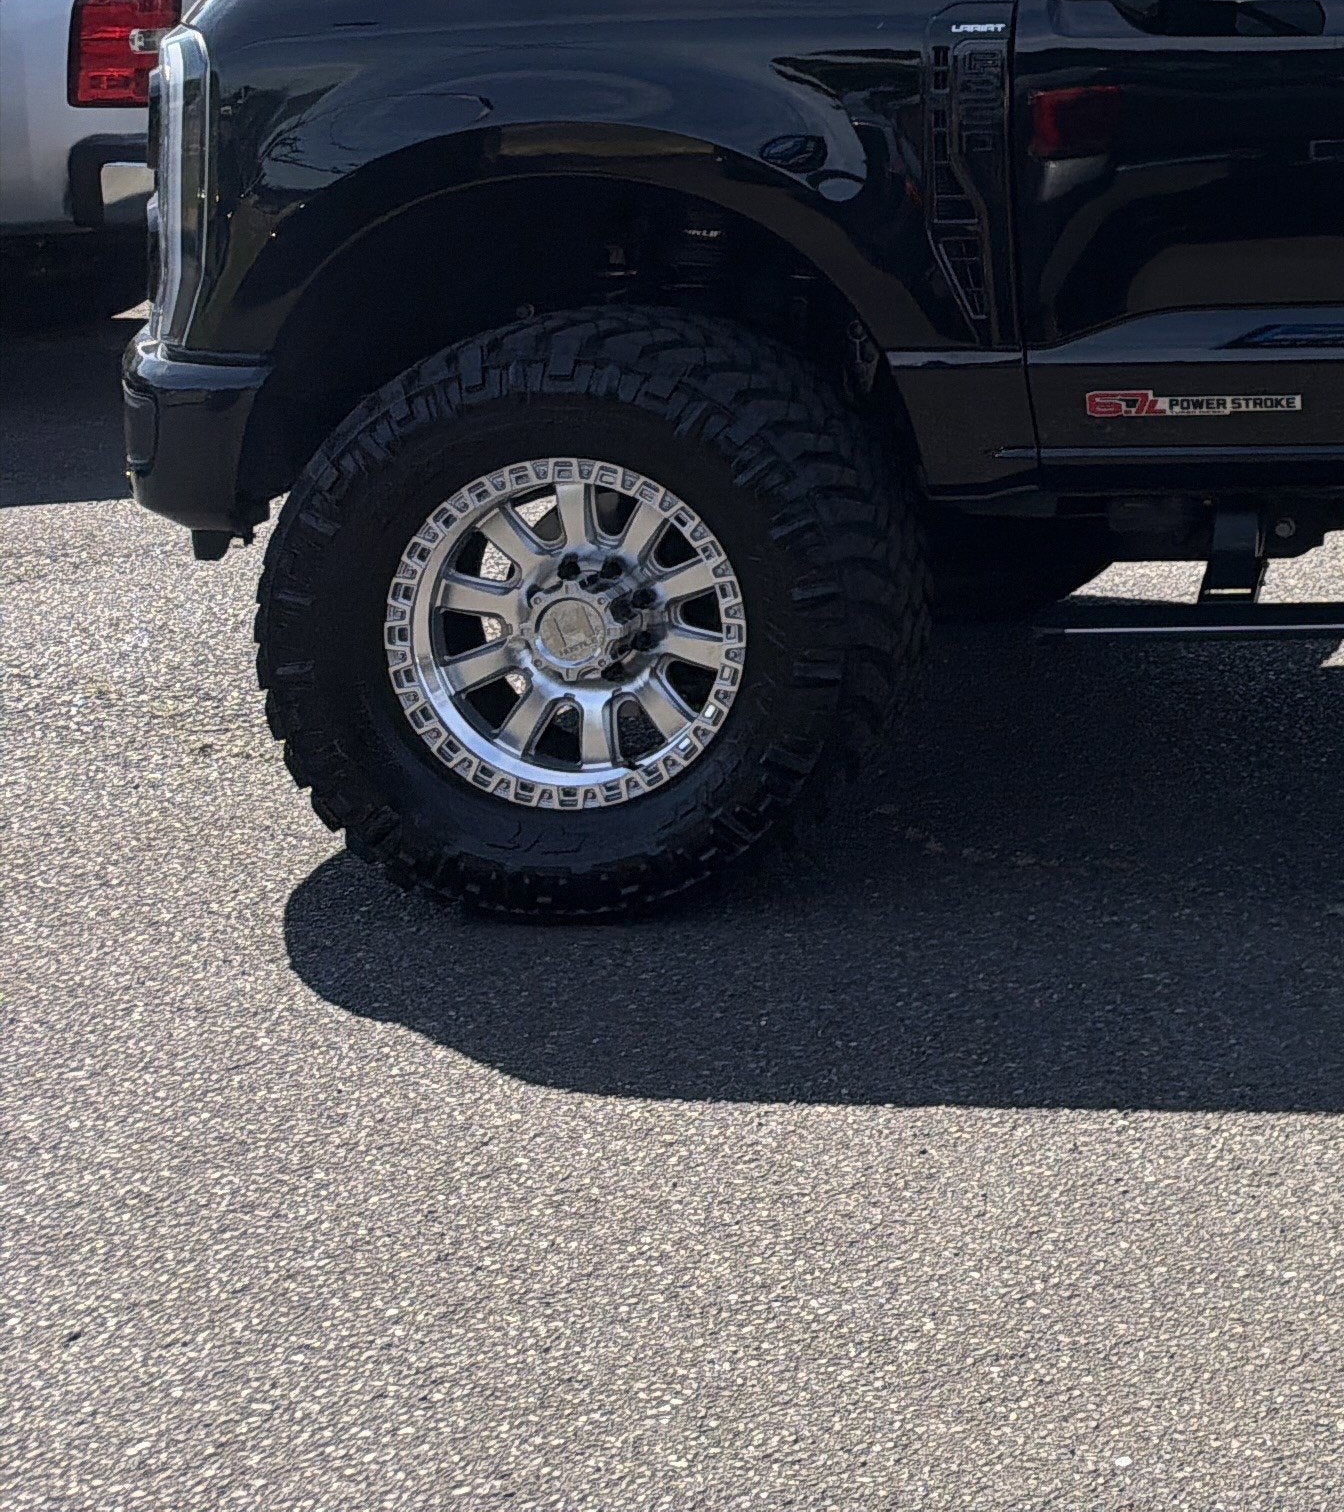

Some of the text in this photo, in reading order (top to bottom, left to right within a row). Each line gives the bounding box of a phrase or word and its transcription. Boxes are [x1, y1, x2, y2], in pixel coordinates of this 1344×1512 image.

[1087, 391, 1297, 416] 6.7L POWER STROKE
